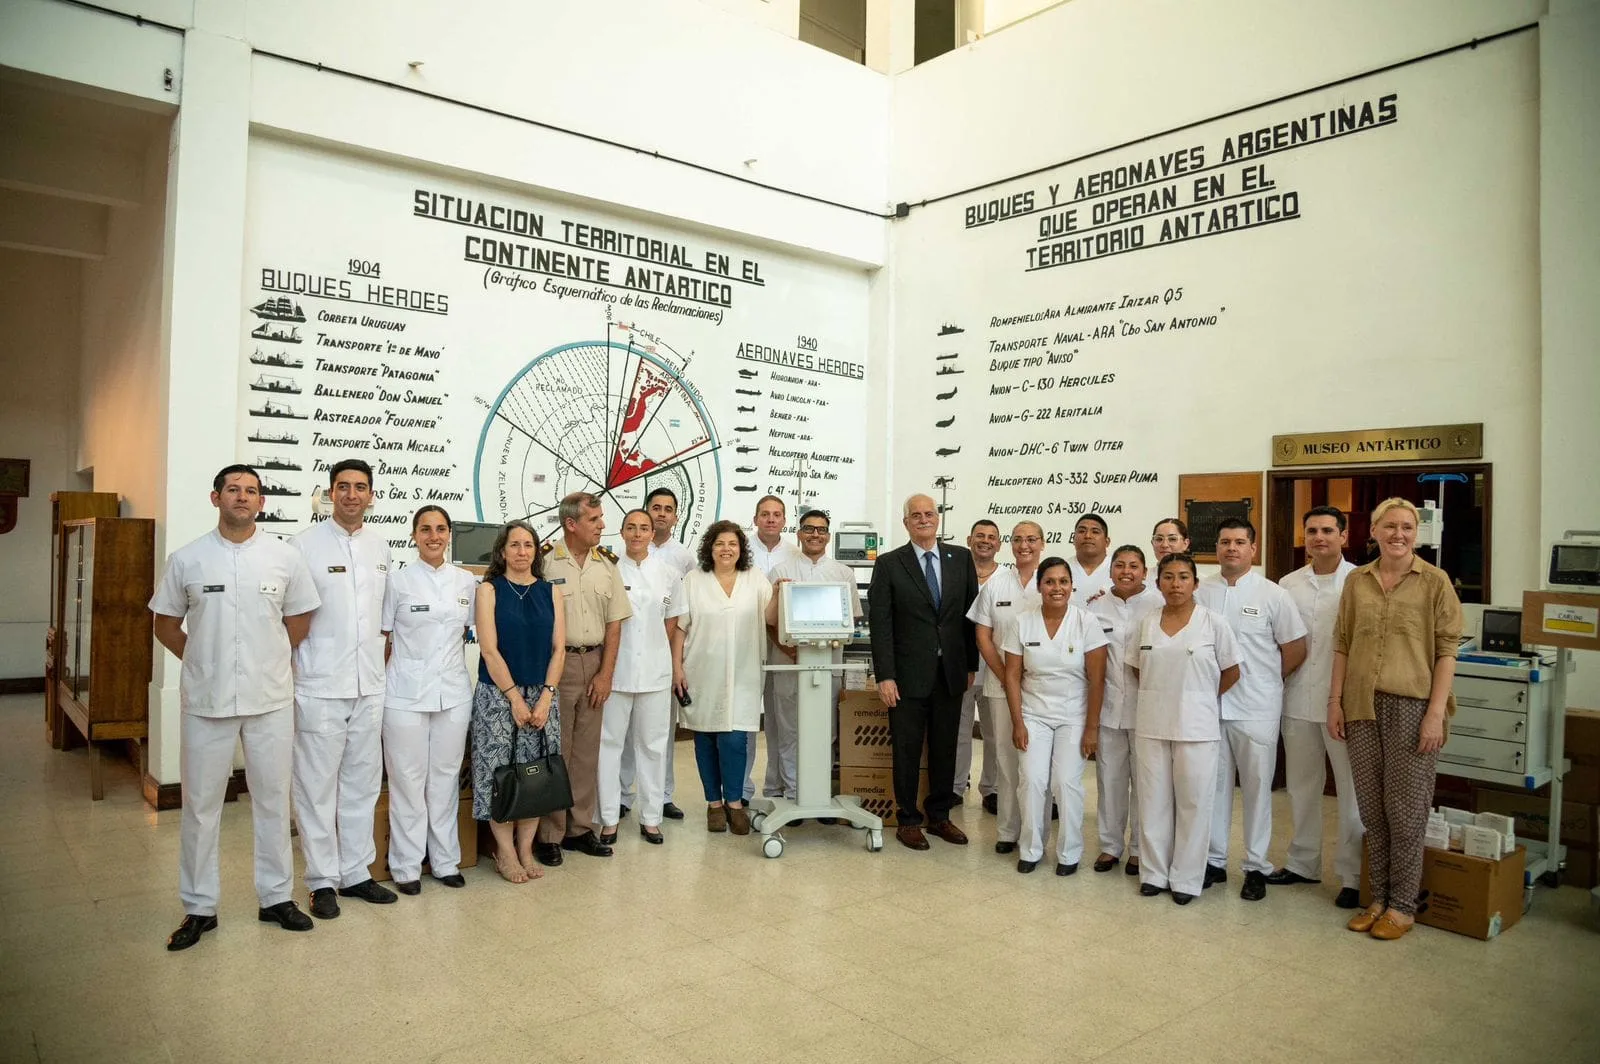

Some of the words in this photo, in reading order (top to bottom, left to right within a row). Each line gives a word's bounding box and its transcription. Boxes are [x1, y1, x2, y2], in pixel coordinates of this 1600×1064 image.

[965, 190, 1035, 226] BUQUES
[1048, 184, 1060, 206] Y
[1074, 145, 1205, 200] AERONAVES
[1222, 93, 1398, 162] ARGENTINAS
[1039, 209, 1078, 239] QUE
[1093, 186, 1177, 227] OPERAN
[1194, 173, 1225, 202] EN
[1242, 164, 1275, 192] EL
[414, 189, 543, 237] SITUACION
[561, 220, 693, 268] TERRITORIAL
[705, 251, 729, 276] EN
[742, 259, 764, 283] EL
[1026, 225, 1144, 268] TERRITORIO
[1159, 191, 1299, 242] ANTARTICO
[348, 259, 381, 278] 1904
[464, 235, 609, 282] CONTINENTE
[625, 266, 731, 304] ANTARTICO
[262, 268, 351, 299] BUQUES
[368, 283, 448, 313] HEROES
[483, 267, 537, 292] (Gráfico
[543, 278, 617, 304] Esquemático
[620, 293, 632, 306] de
[634, 294, 649, 310] las
[651, 296, 723, 326] Reclamaciones)
[1064, 301, 1116, 317] ALMIRANTE
[1118, 294, 1159, 309] IRIZAR
[1163, 287, 1183, 305] Q5
[317, 310, 357, 326] CORBETA
[361, 317, 406, 332] URUGUAY
[316, 333, 382, 353] TRANSPORTE
[399, 347, 411, 356] DE
[797, 335, 818, 350] 1940
[989, 337, 1048, 354] TRANSPORTE
[1144, 319, 1165, 334] SAN
[315, 358, 378, 377] TRANSPORTE
[736, 342, 813, 369] AERONAVES
[818, 357, 864, 379] HEROES
[989, 359, 1020, 372] BUQUE
[1022, 356, 1043, 369] TIPO
[535, 383, 583, 394] RECLAMADO
[1059, 373, 1115, 388] HERCULES
[314, 384, 374, 400] BALLENERO
[313, 408, 382, 426] RASTREADOR
[1054, 406, 1103, 418] AERITALIA
[312, 432, 370, 450] TRANSPORTE
[768, 428, 796, 440] NEPTUNE
[500, 437, 513, 466] NUEVA
[768, 445, 808, 460] HELICOPTERO
[1063, 440, 1089, 453] TWIN
[1093, 440, 1124, 452] OTTER
[1302, 441, 1350, 455] MUSEO
[1356, 436, 1441, 452] ANTÁRTICO
[809, 469, 821, 479] SEA
[988, 475, 1043, 487] HELICOPTERO
[1047, 472, 1088, 485] AS-332
[1093, 471, 1126, 485] SUPER
[1128, 470, 1158, 484] PUMA
[412, 487, 424, 500] S.
[498, 471, 509, 520] ZELANDIA
[690, 482, 706, 536] NORUEGA
[988, 502, 1043, 515] HELICOPTERO
[1047, 501, 1086, 515] SA-330
[1091, 502, 1122, 514] PUMA
[1046, 531, 1061, 544] 212
[853, 786, 886, 795] remediar
